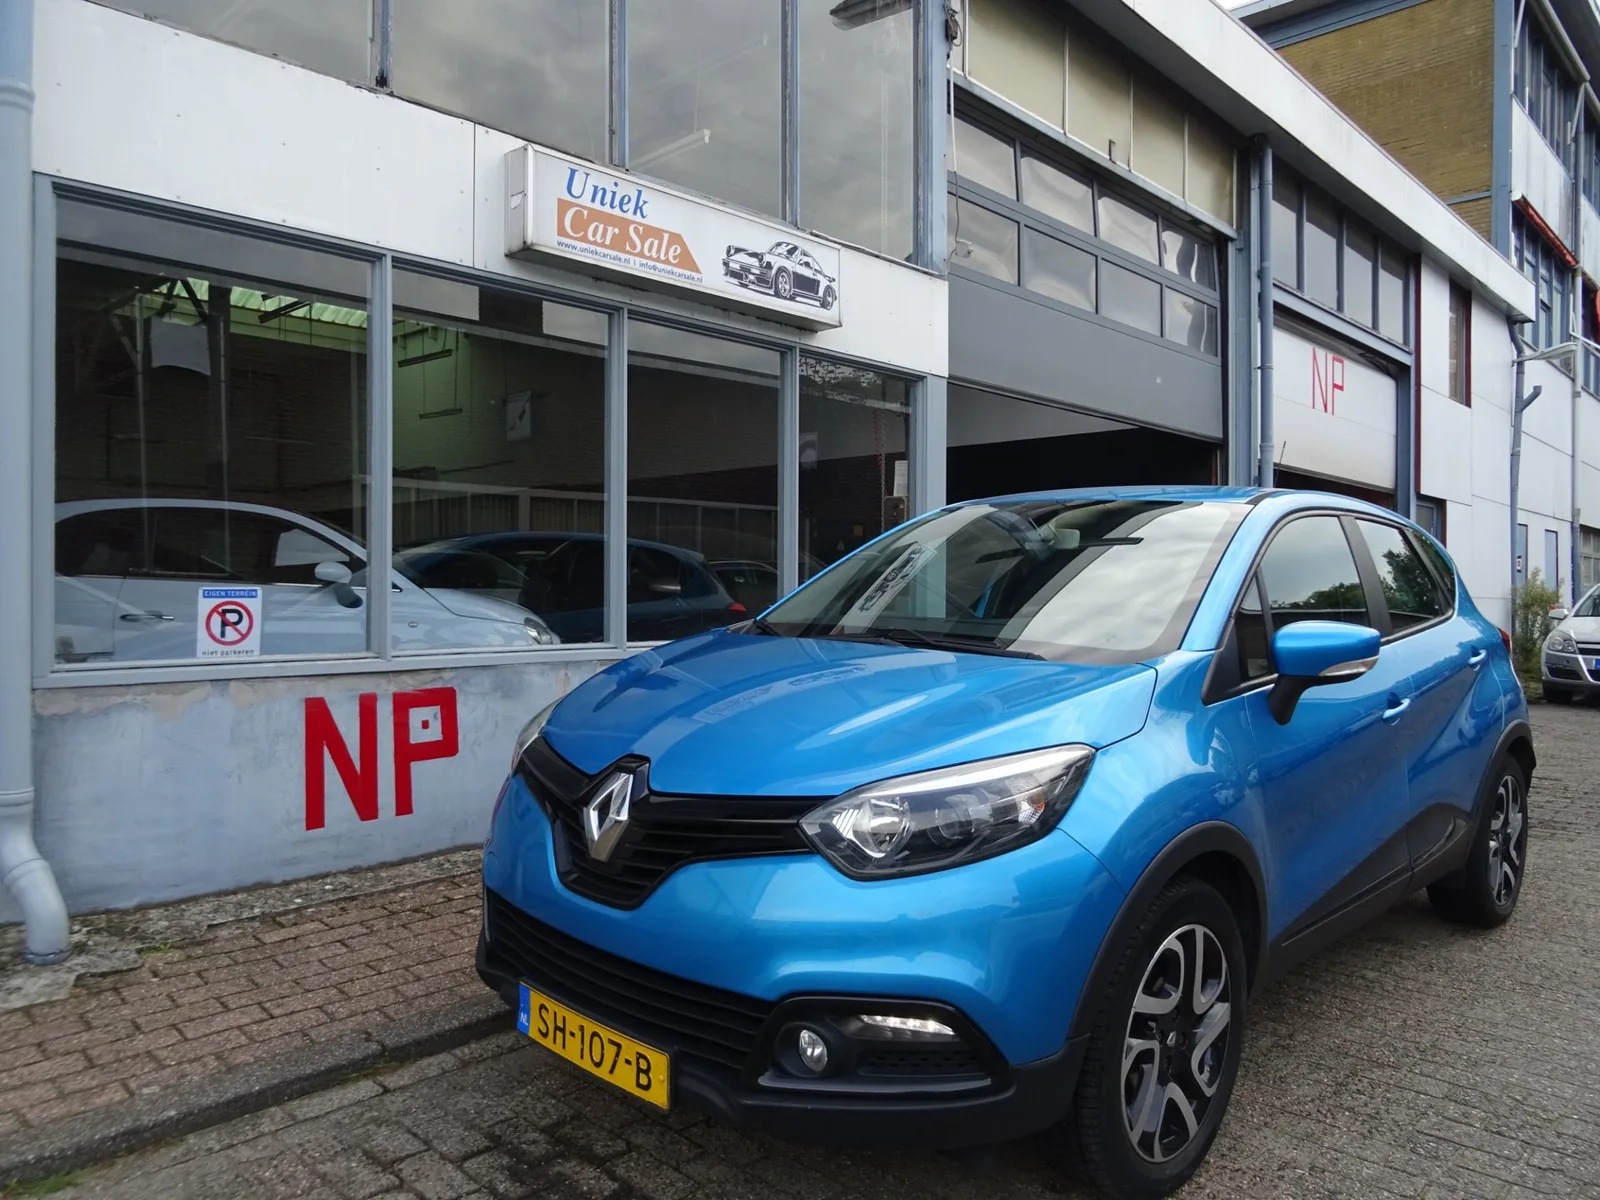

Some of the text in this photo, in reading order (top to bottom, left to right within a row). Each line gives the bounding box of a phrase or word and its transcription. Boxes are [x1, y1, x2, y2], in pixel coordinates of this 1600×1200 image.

[566, 167, 648, 219] Uniek
[557, 240, 703, 283] www.uniekcarsale.nl info@uniekcarsale.nl
[564, 206, 681, 264] Car Sale
[1312, 346, 1345, 415] NP
[220, 649, 254, 657] parkeren
[305, 686, 459, 832] NP
[520, 1011, 529, 1026] NL
[538, 1003, 652, 1091] SH-107-B
